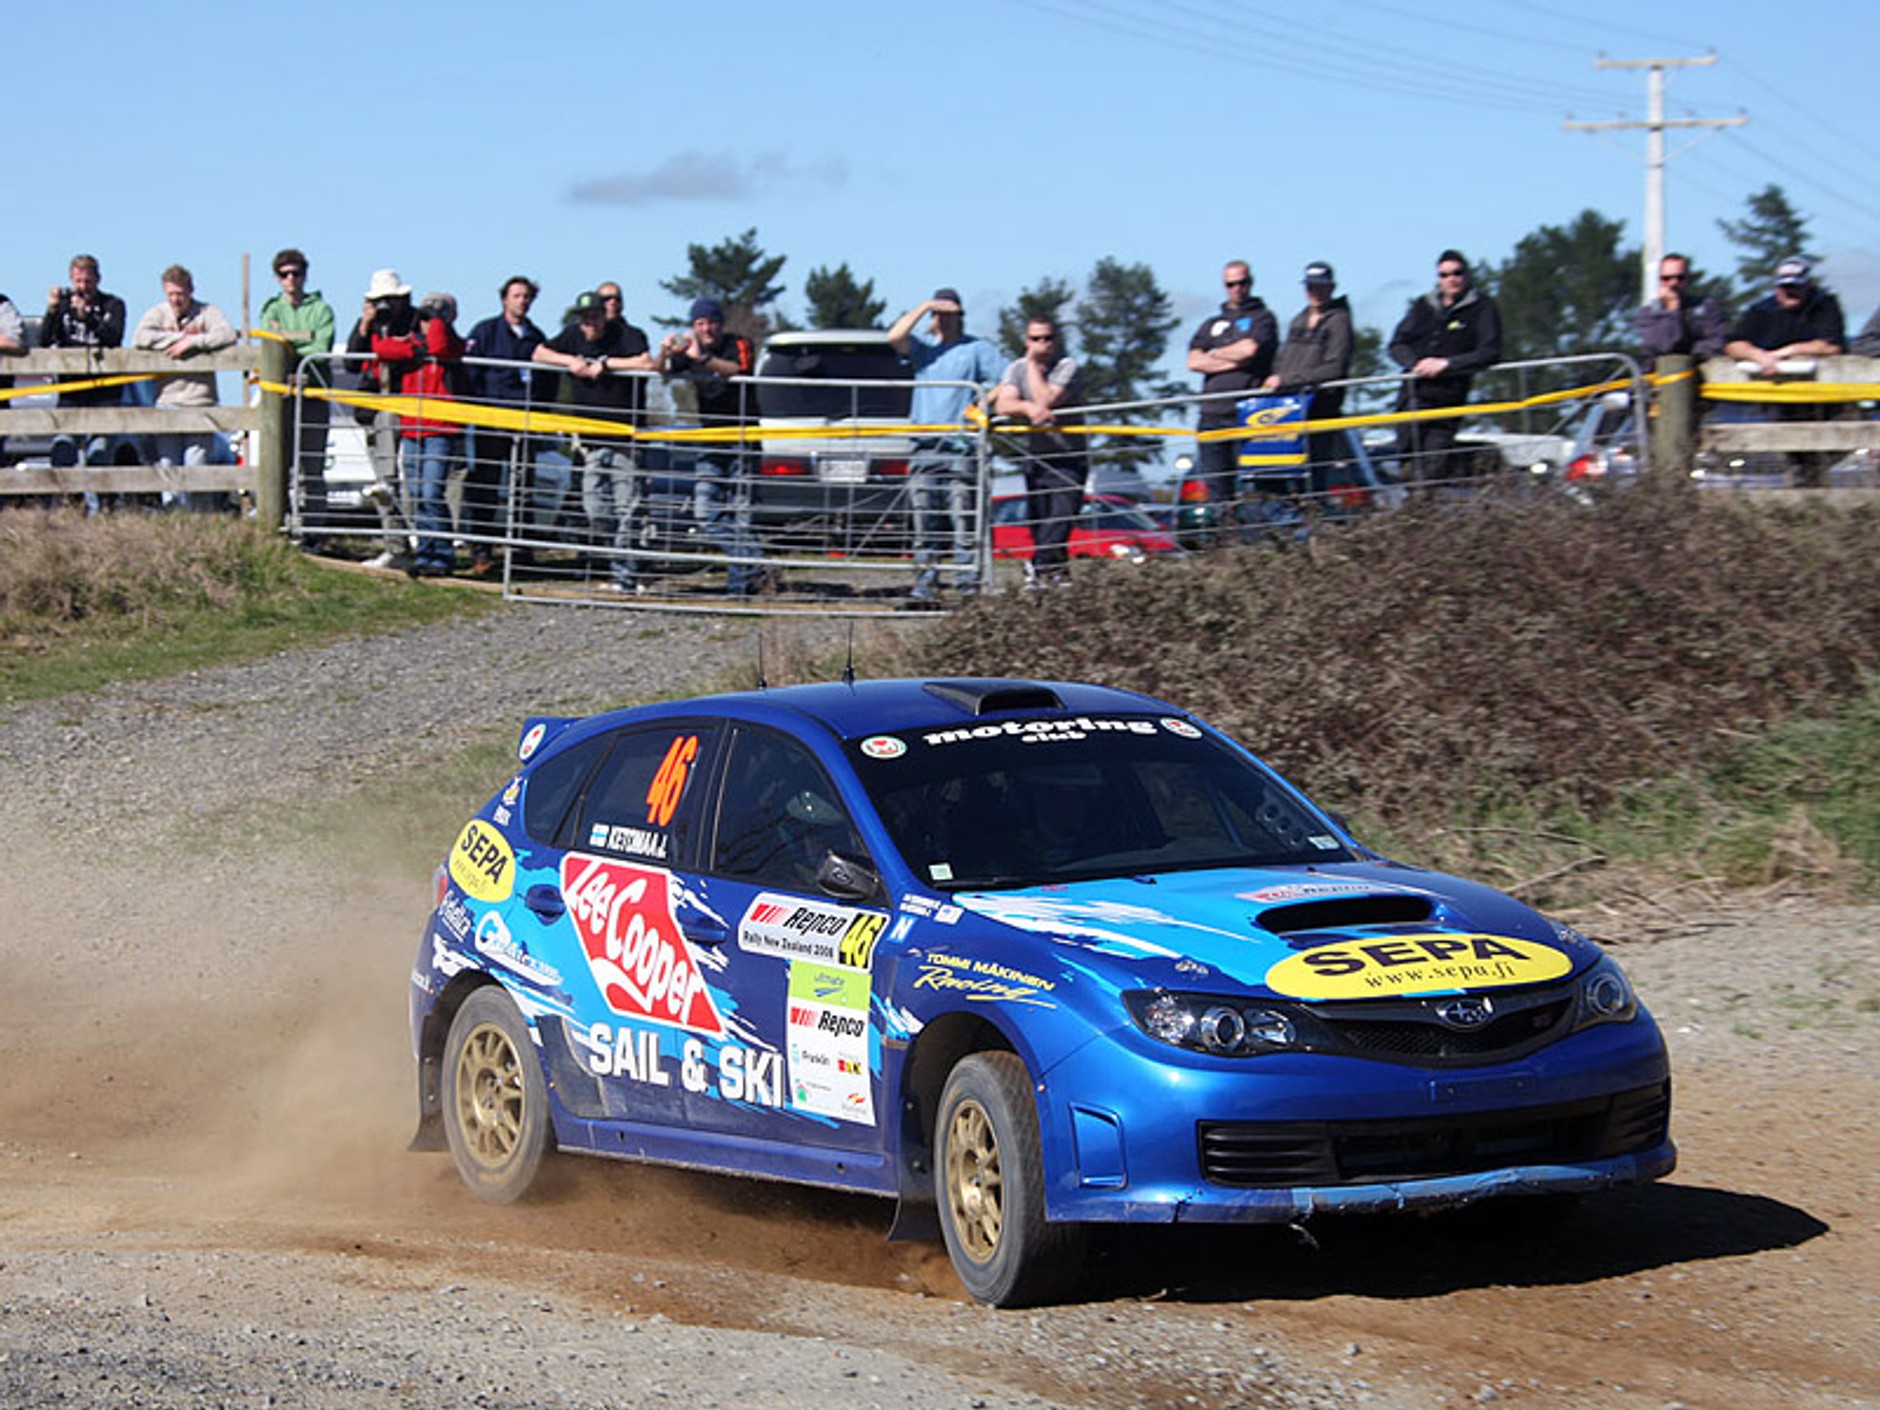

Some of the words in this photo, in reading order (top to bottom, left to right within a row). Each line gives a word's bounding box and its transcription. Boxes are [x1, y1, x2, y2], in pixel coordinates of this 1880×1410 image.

[922, 717, 1157, 746] motoring
[1021, 731, 1086, 743] club
[645, 735, 698, 827] 46
[460, 823, 508, 884] SEPA
[783, 907, 848, 936] Repco
[565, 858, 616, 935] Lee
[605, 878, 704, 1026] Cooper
[744, 930, 763, 947] Rally
[763, 935, 779, 947] New
[781, 935, 812, 955] Zealand
[840, 915, 883, 970] 46
[1303, 938, 1531, 977] SEPA
[926, 953, 972, 970] TOMMI
[1364, 961, 1515, 987] www.sepa.fi
[913, 965, 1039, 1000] Racing
[818, 1010, 866, 1037] Repco
[589, 1022, 671, 1086] SAIL
[681, 1038, 710, 1092] &
[720, 1045, 786, 1109] SKI
